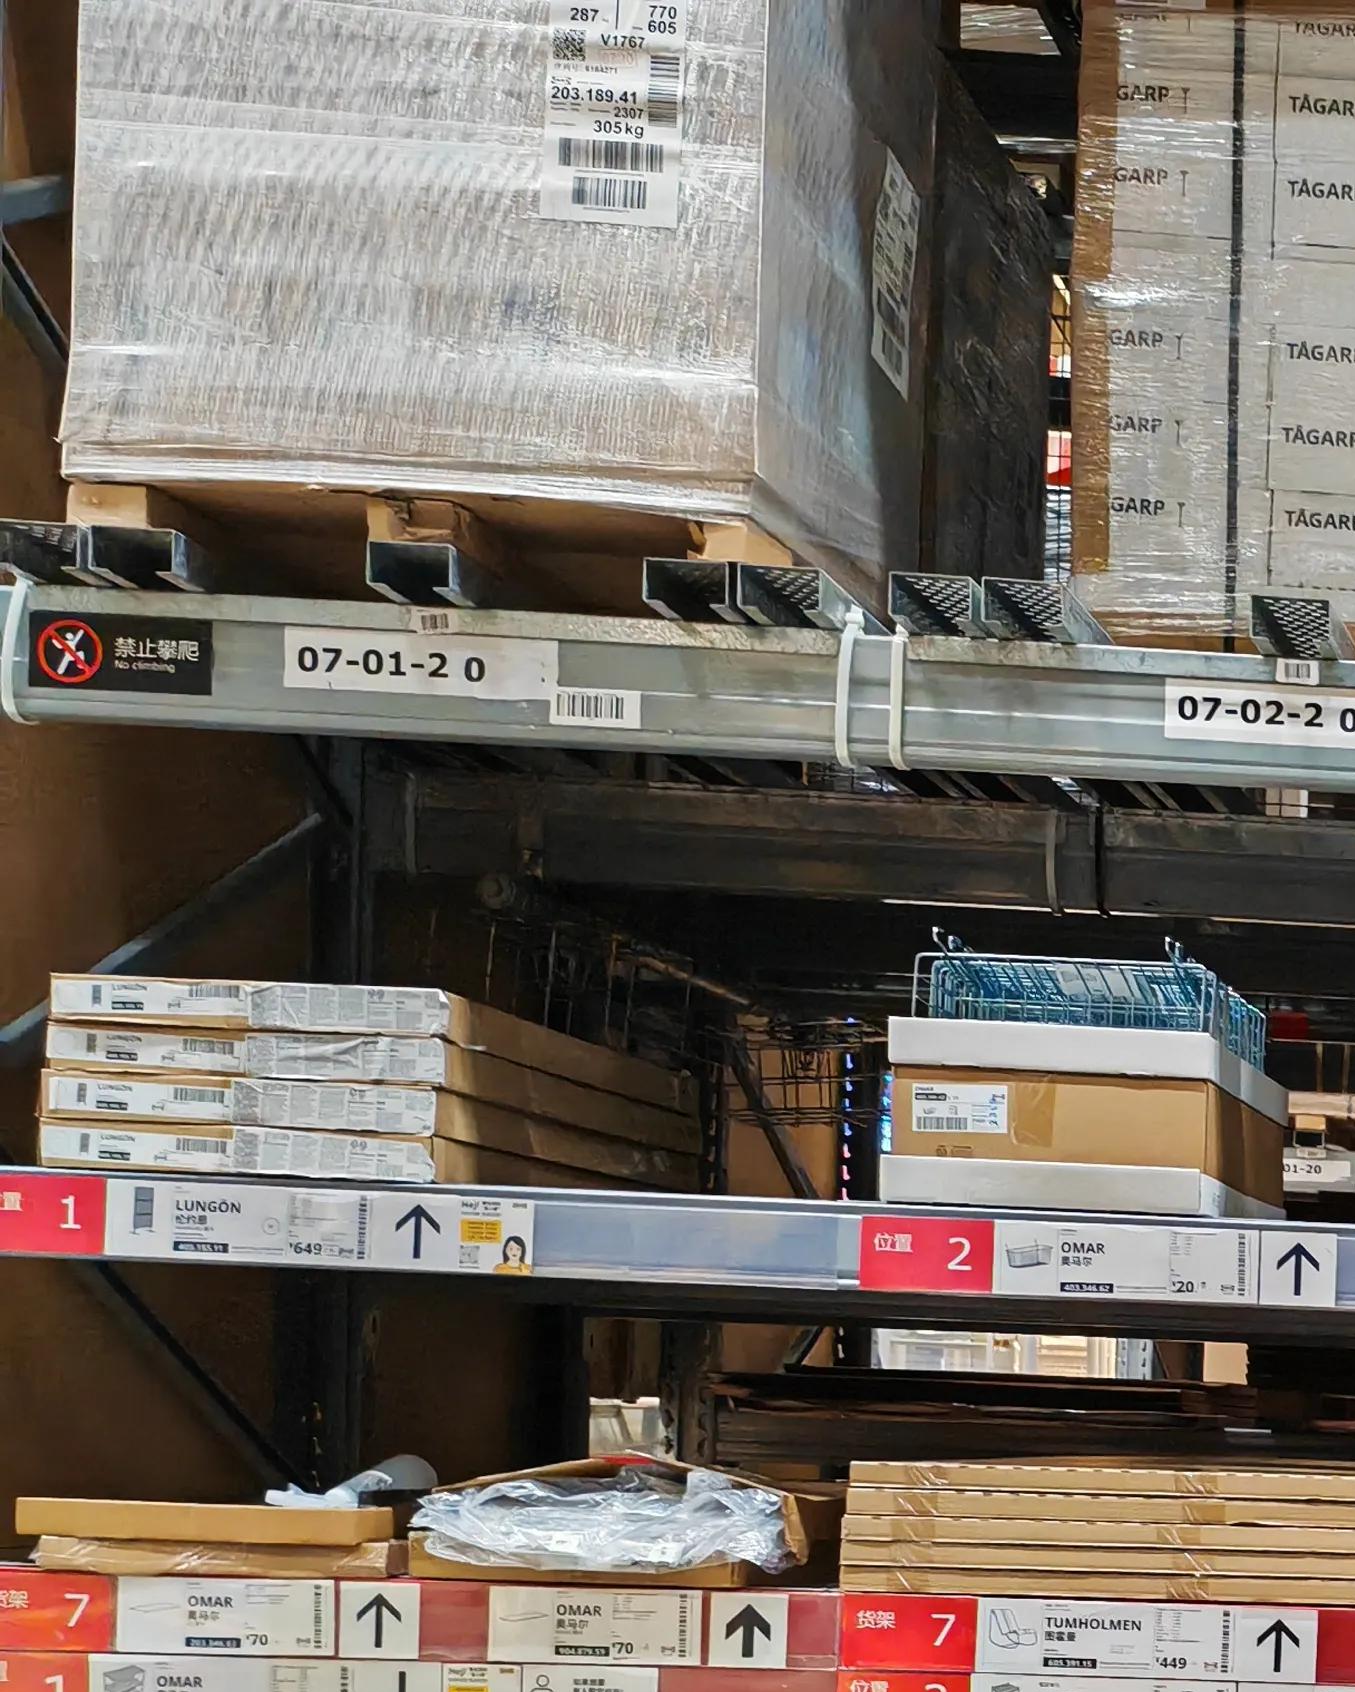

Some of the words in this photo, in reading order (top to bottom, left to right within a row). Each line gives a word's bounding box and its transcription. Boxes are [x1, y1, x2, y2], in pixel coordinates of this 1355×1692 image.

[570, 7, 599, 22] 287
[649, 5, 677, 20] 770
[648, 20, 677, 34] 605
[601, 33, 646, 48] V1767
[551, 86, 638, 105] 203.189.41
[614, 106, 644, 119] 2307
[114, 636, 199, 662] 禁止攀爬
[115, 659, 130, 671] No
[0, 1191, 23, 1212] 置
[60, 1195, 82, 1230] 1
[947, 1236, 973, 1271] 2
[1060, 1241, 1106, 1256] OMAR
[187, 1595, 234, 1608] OMAR
[64, 1592, 90, 1627] 7
[556, 1603, 602, 1617] OMAR
[856, 1610, 896, 1629] 货架
[1045, 1616, 1142, 1633] TUMHOLMEN
[931, 1613, 956, 1647] 7
[156, 1675, 204, 1689] OMAR
